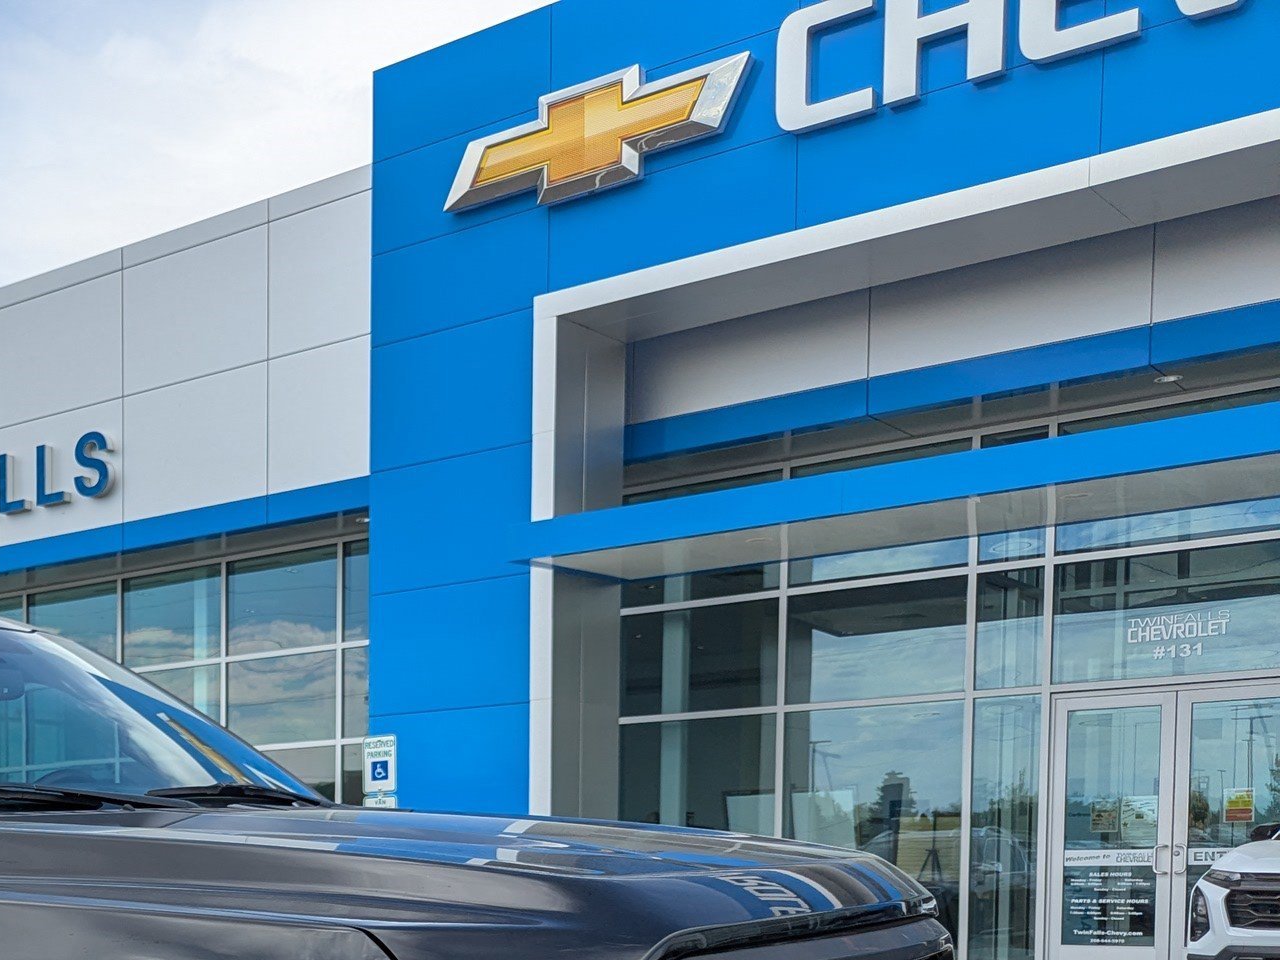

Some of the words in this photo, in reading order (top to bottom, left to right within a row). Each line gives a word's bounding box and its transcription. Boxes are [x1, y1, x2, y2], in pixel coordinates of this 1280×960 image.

[1128, 619, 1229, 643] CHEVROLET
[1153, 642, 1204, 660] #131
[365, 740, 394, 749] RESERVED
[367, 750, 392, 758] PARKING
[1065, 855, 1101, 863] Welcome
